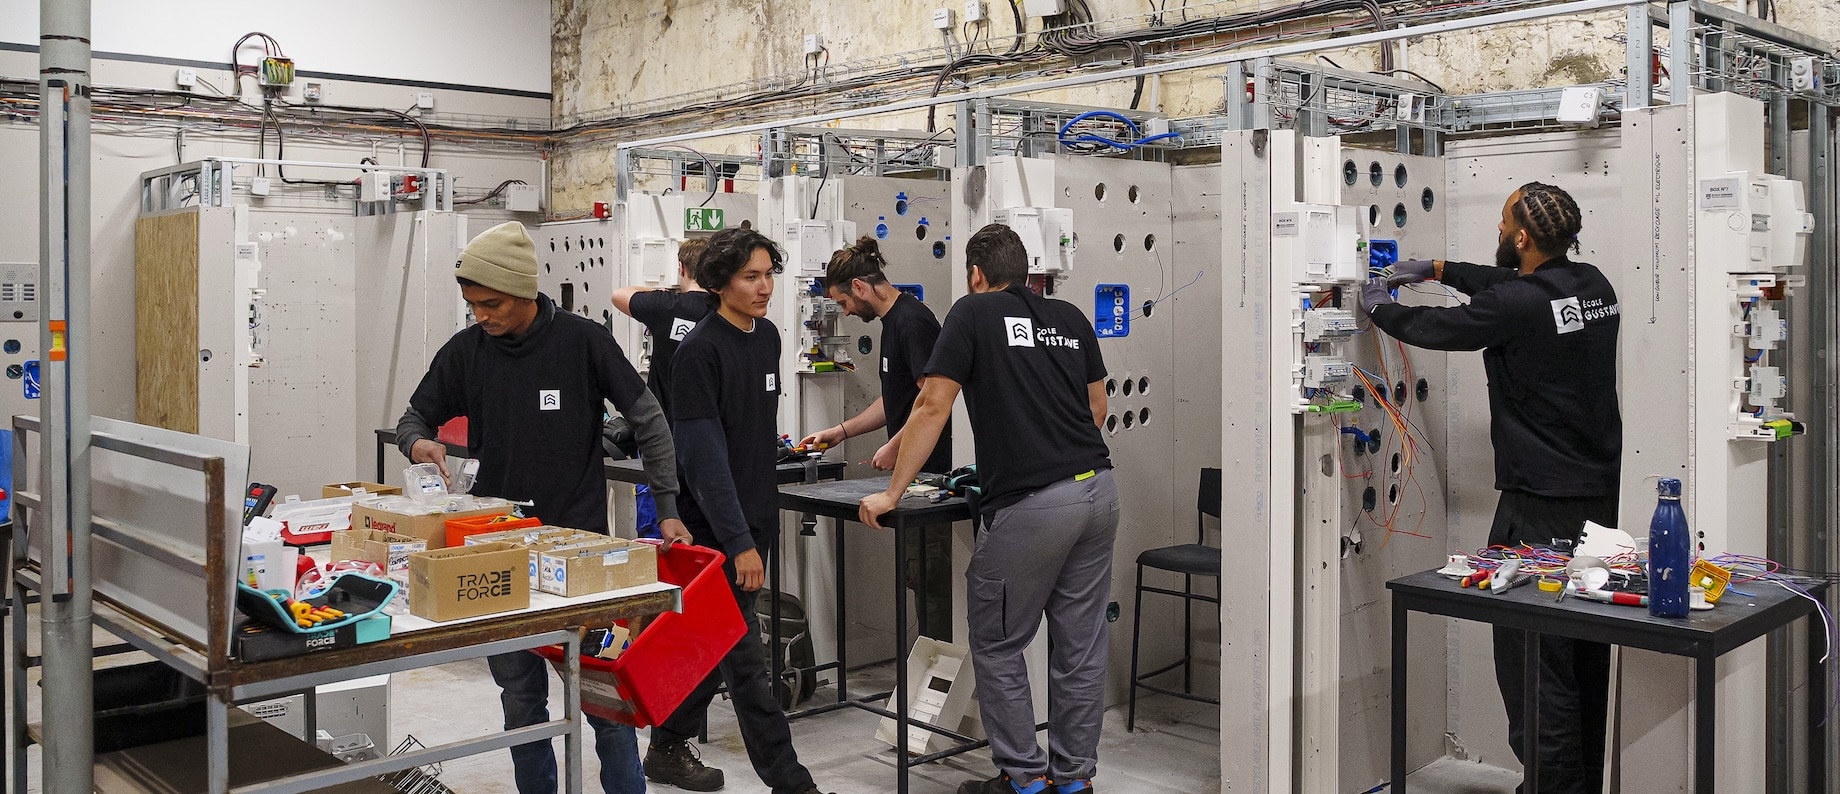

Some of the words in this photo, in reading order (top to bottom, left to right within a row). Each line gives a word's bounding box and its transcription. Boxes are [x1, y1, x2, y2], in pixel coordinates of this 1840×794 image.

[372, 517, 395, 533] legrand
[457, 570, 511, 588] TRADE
[457, 583, 511, 602] FORCE
[305, 636, 336, 648] FORCE
